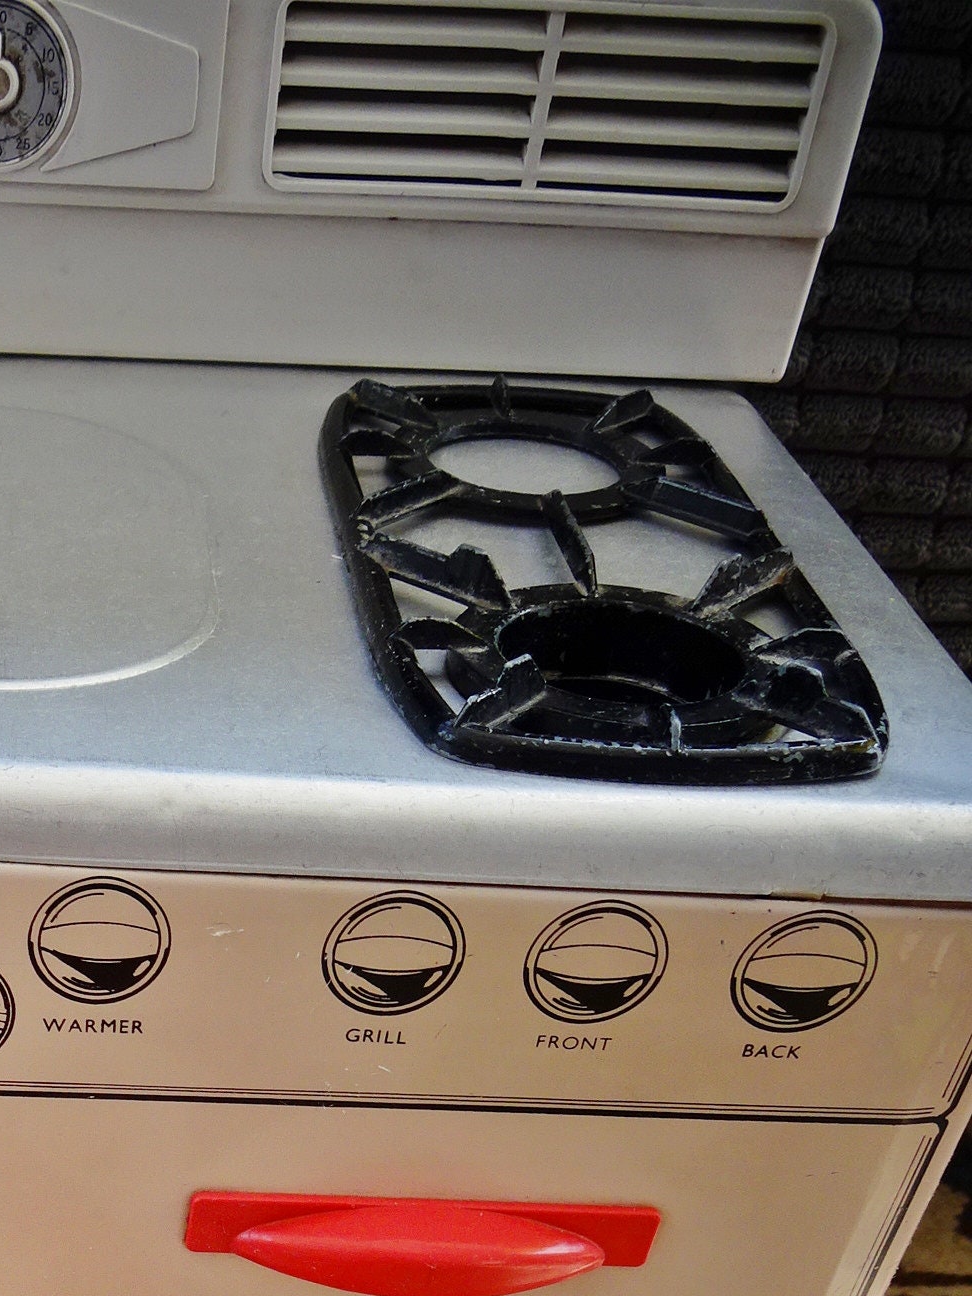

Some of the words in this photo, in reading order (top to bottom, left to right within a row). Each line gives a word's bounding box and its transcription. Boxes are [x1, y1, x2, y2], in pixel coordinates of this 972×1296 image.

[41, 47, 55, 63] 10
[47, 81, 59, 96] 15
[37, 114, 53, 126] 20
[42, 1017, 145, 1035] WARMER
[345, 1028, 407, 1045] GRILL
[535, 1034, 613, 1051] FRONT
[741, 1043, 801, 1060] BACK
